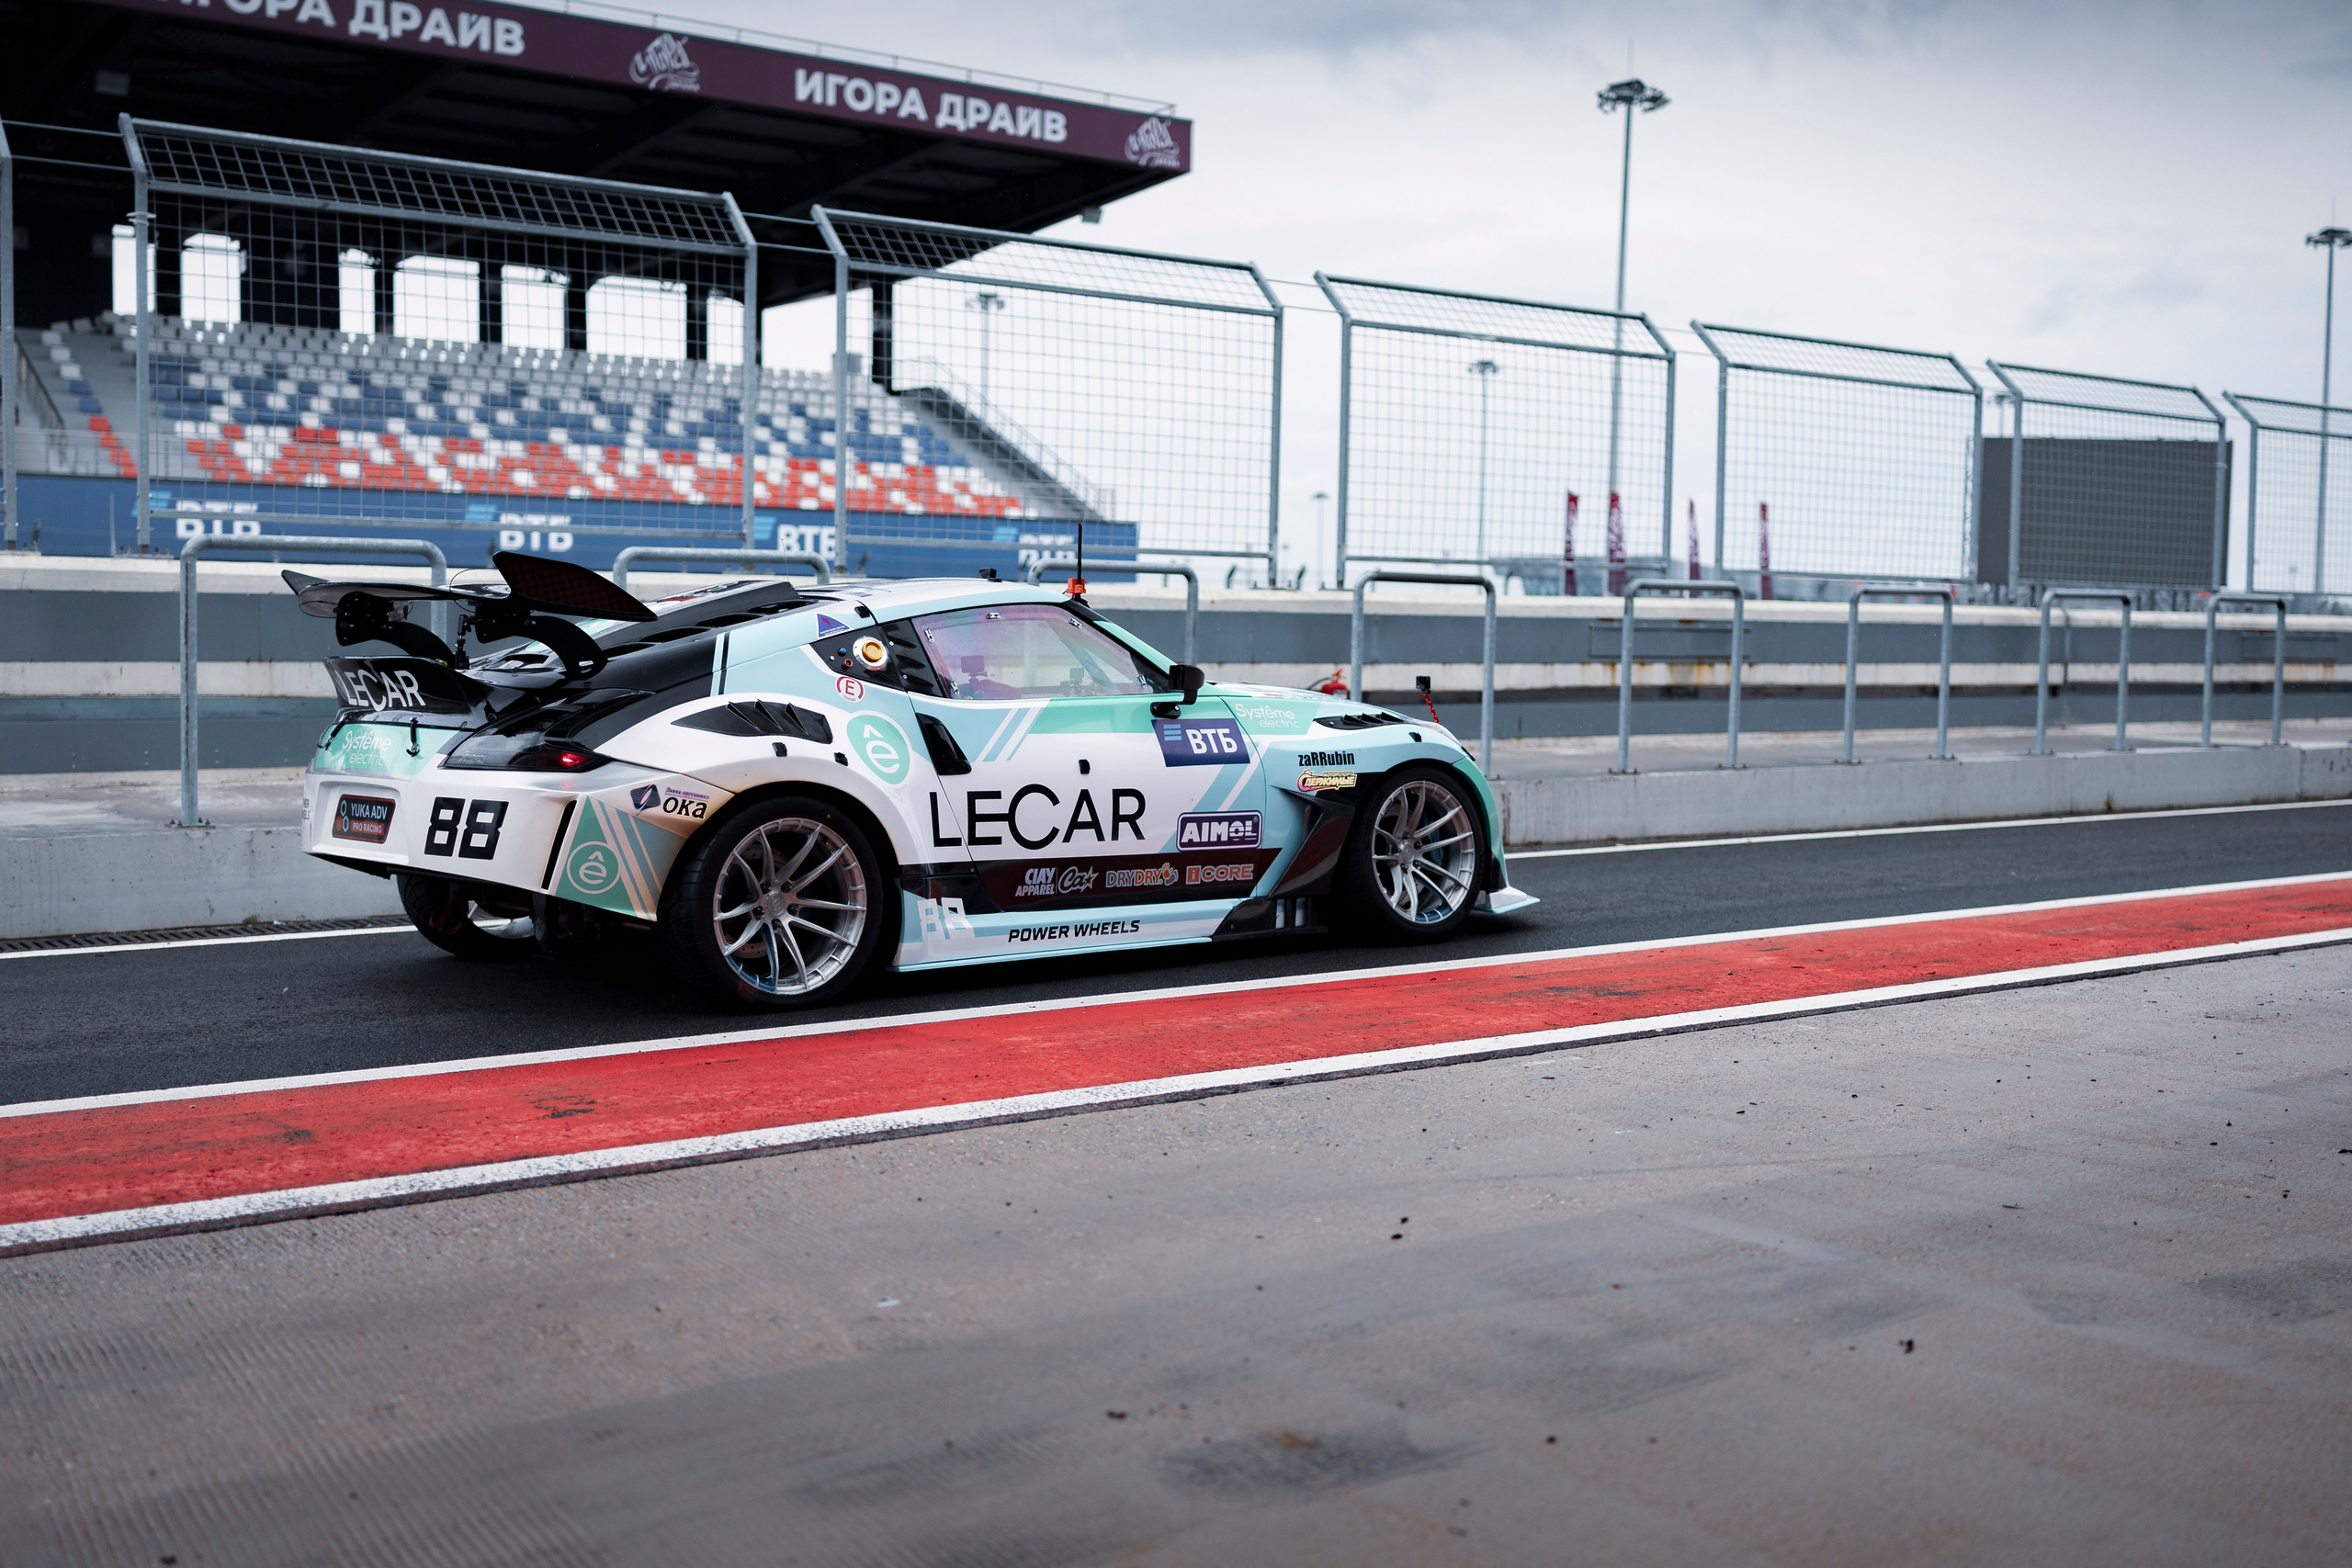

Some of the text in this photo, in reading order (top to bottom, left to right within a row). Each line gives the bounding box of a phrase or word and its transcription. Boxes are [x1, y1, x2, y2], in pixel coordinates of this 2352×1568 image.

[348, 0, 526, 56] ДРАЙВ
[794, 68, 929, 122] ИГОРА
[934, 92, 1069, 143] ДРАЙВ
[334, 669, 426, 712] LECAR
[1259, 719, 1301, 728] electric
[1185, 728, 1238, 755] ВТБ
[349, 750, 386, 766] electric
[1297, 750, 1355, 767] zaRRubin
[351, 803, 388, 820] YUKA ADV
[929, 783, 1147, 851] LECAR
[353, 822, 382, 834] PRO RACING
[424, 796, 509, 860] 88
[1181, 820, 1257, 843] AIMOL
[1014, 884, 1055, 897] APPAREL
[917, 897, 976, 942] 88
[1008, 919, 1141, 942] POWER WHEELS
